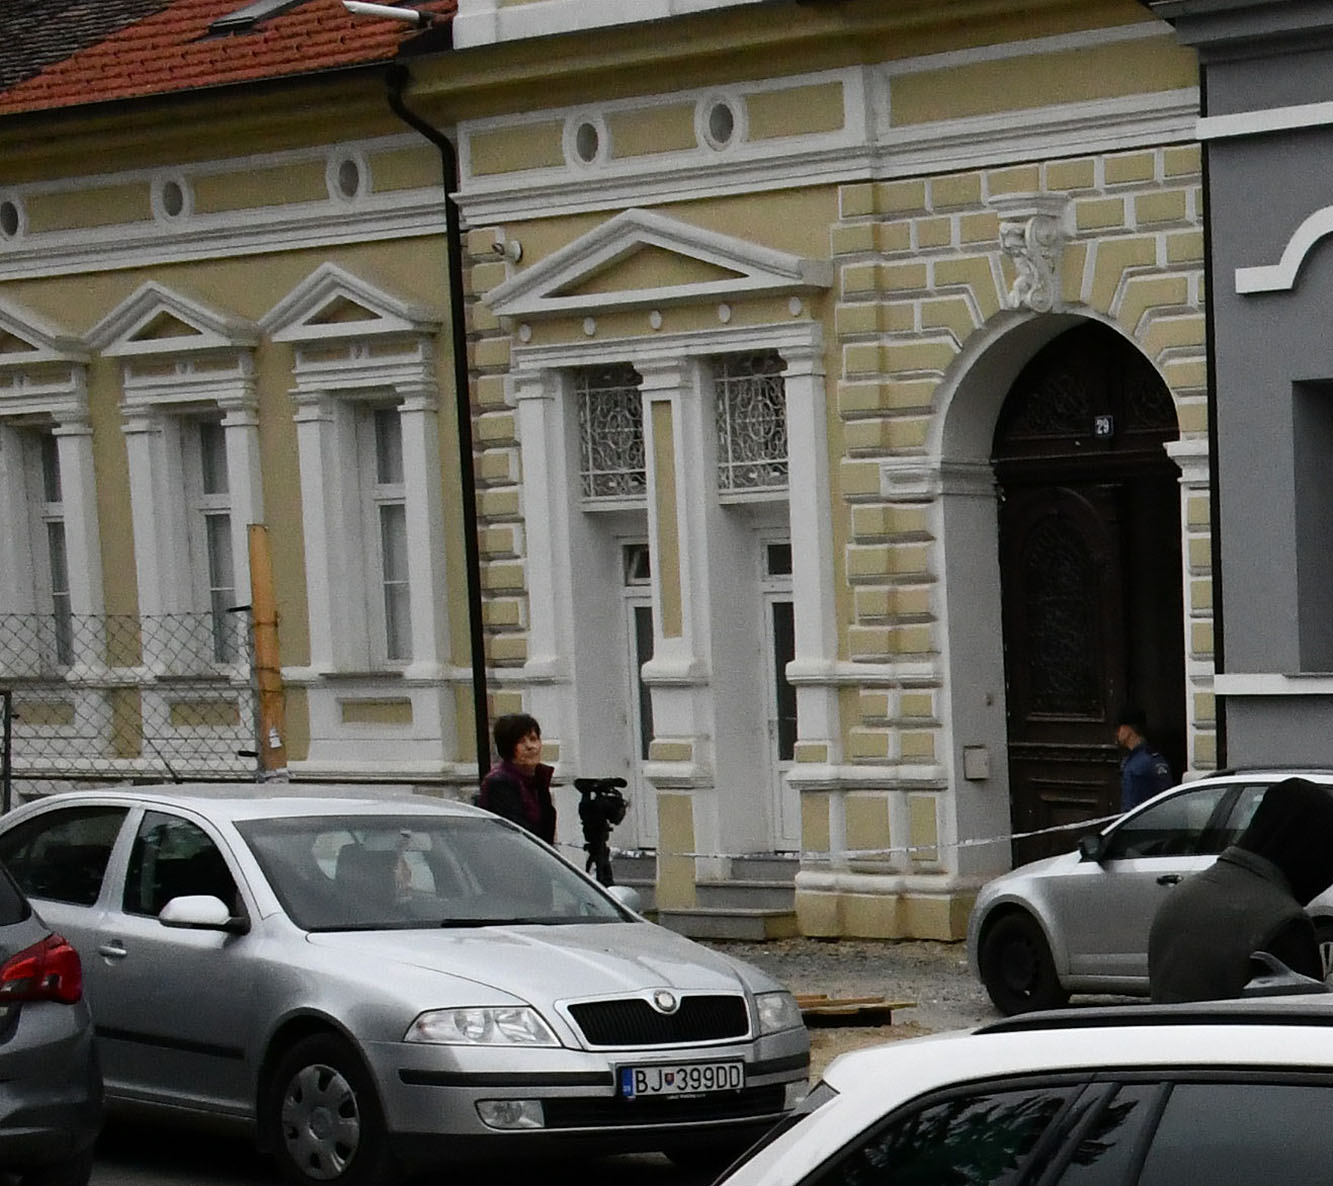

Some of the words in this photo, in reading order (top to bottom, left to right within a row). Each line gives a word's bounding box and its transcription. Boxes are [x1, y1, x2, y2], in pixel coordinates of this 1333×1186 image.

[1096, 417, 1109, 434] 29
[635, 1069, 662, 1093] BJ
[676, 1065, 740, 1090] 399DD
